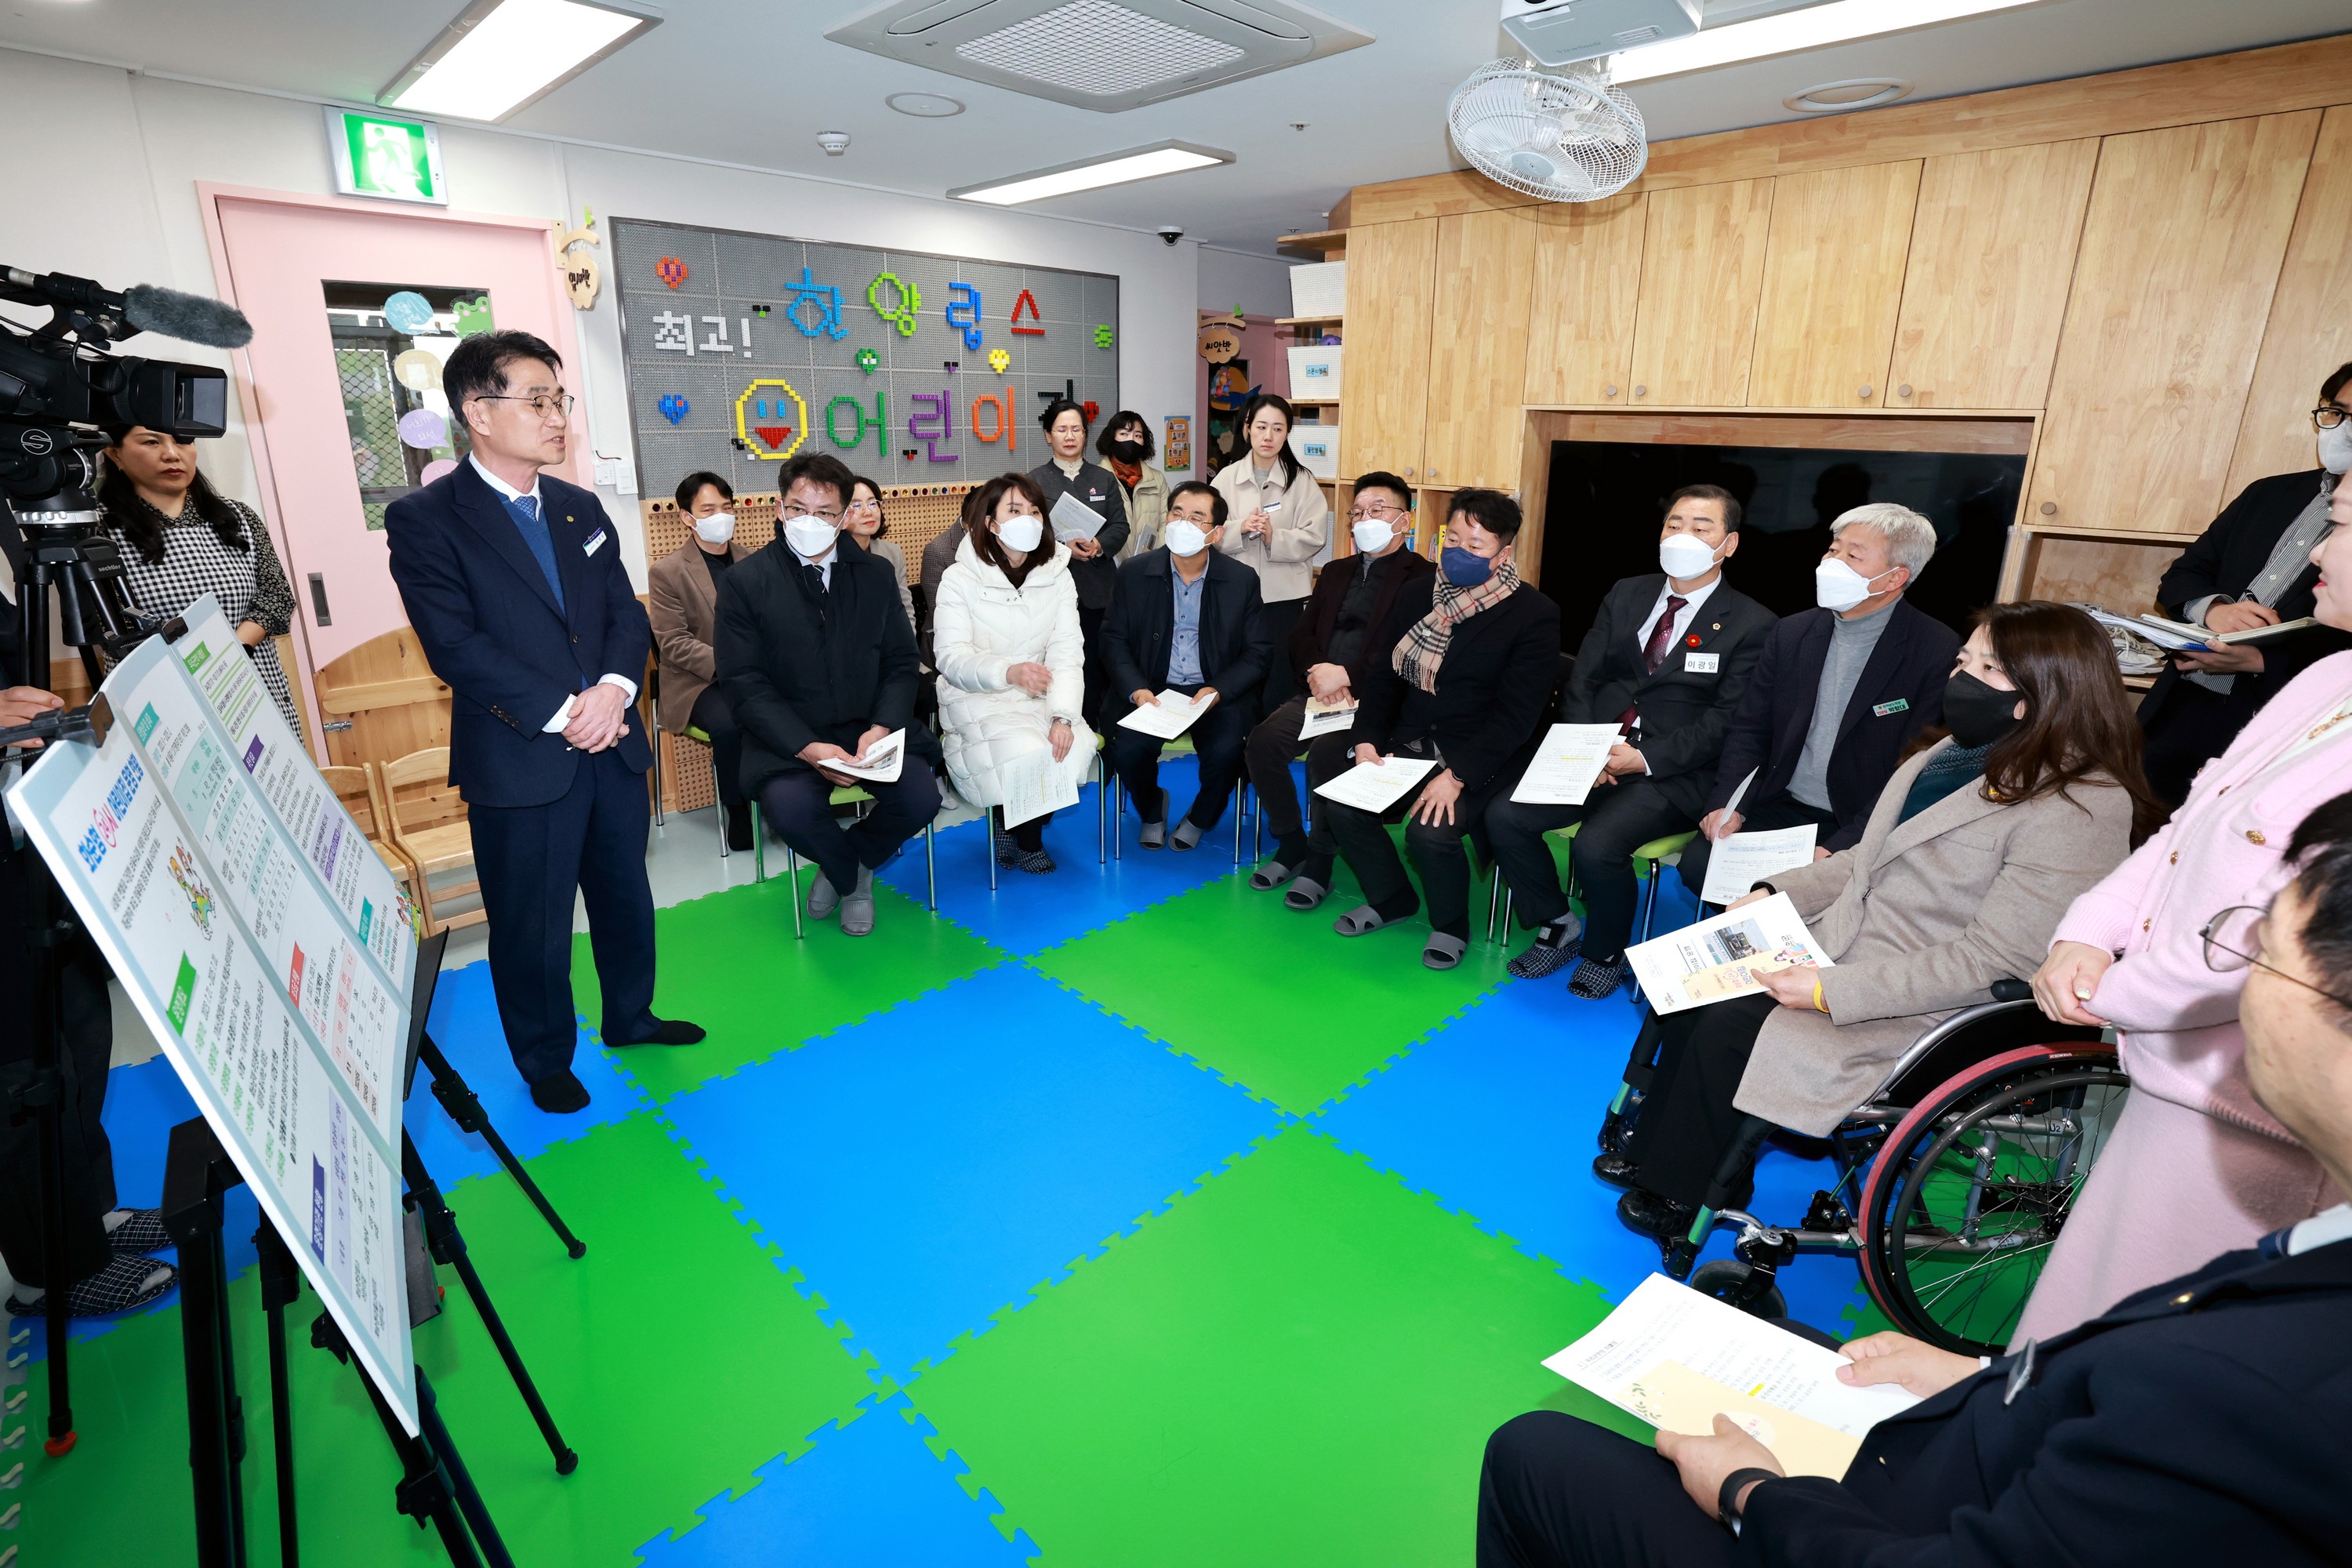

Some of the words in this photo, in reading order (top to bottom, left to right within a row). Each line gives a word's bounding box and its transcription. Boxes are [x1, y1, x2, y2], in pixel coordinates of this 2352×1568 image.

[653, 310, 753, 358] 최고!
[1205, 340, 1232, 353] 씨앗반
[98, 564, 122, 572] sachtler
[120, 764, 139, 794] 운영
[127, 752, 144, 781] 현황
[106, 777, 133, 821] 어린이집
[77, 824, 106, 873] 화순형
